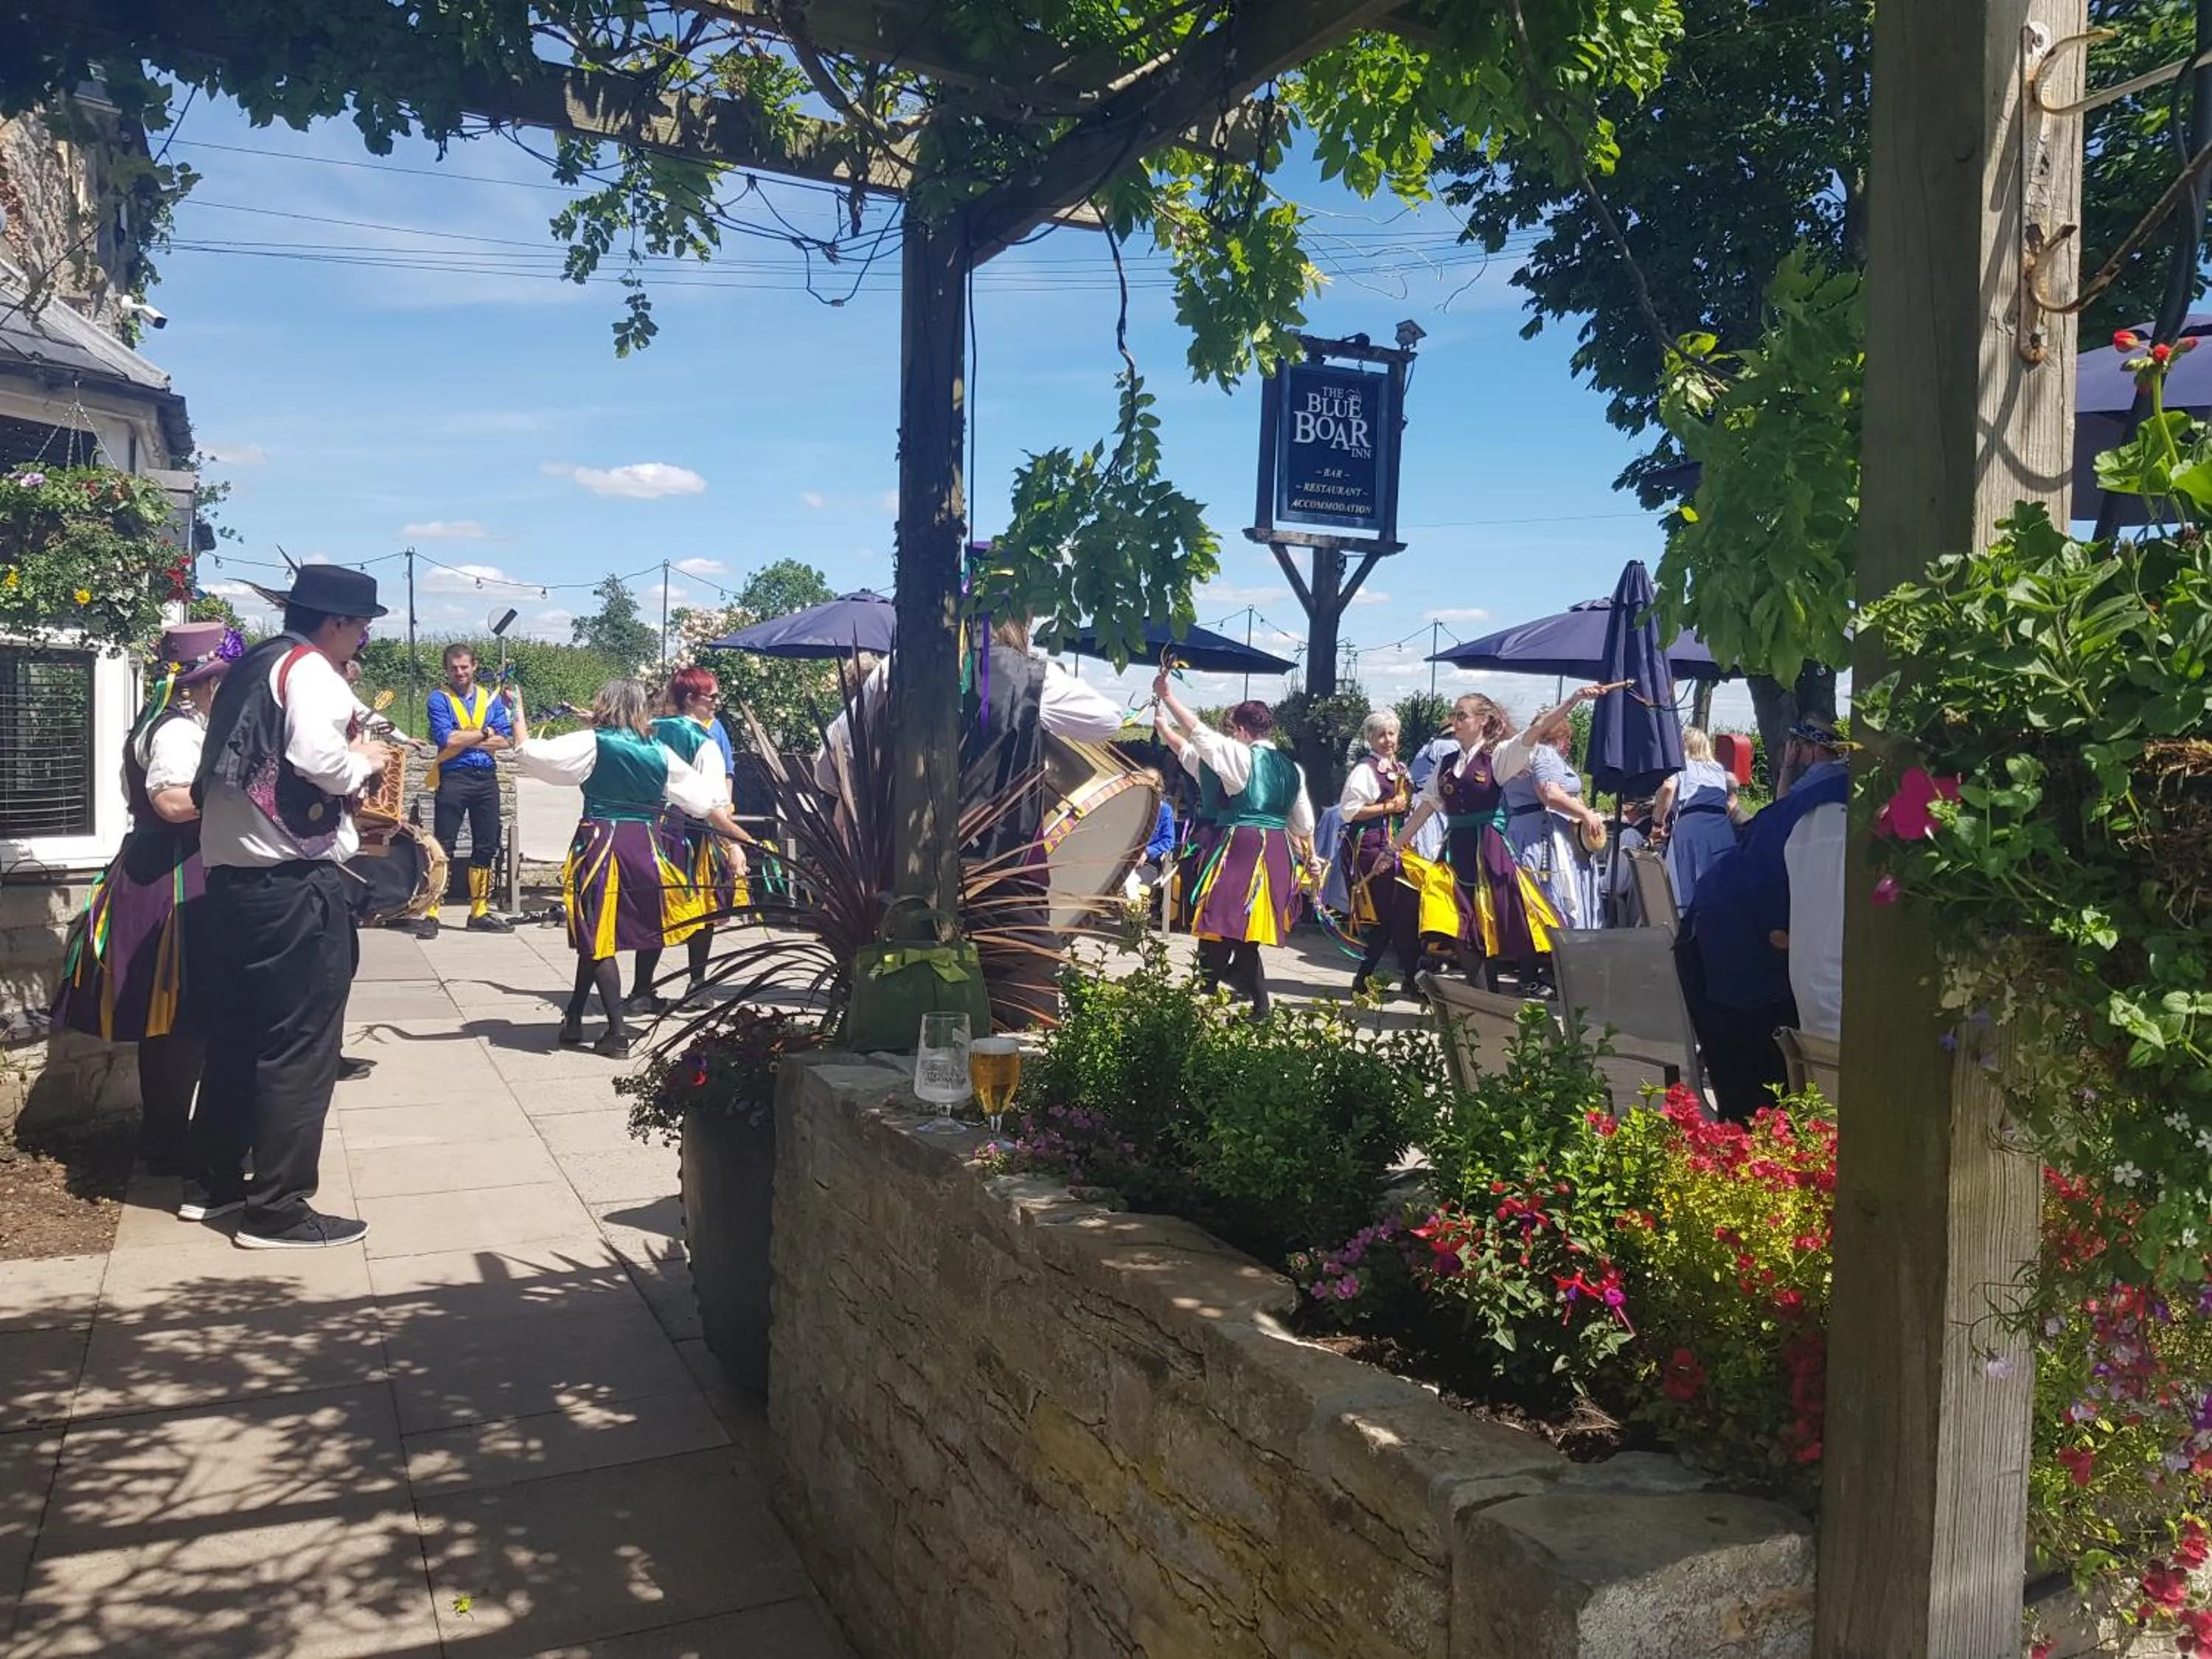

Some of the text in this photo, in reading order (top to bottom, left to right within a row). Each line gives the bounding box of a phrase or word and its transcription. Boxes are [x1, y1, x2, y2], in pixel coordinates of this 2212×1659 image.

[1321, 386, 1344, 398] THE
[1307, 392, 1362, 419] BLUE
[1293, 411, 1371, 451] BOAR
[1352, 448, 1371, 459] INN
[1303, 483, 1362, 497] RESTAURANT
[1291, 498, 1371, 514] ACCOMMODATION
